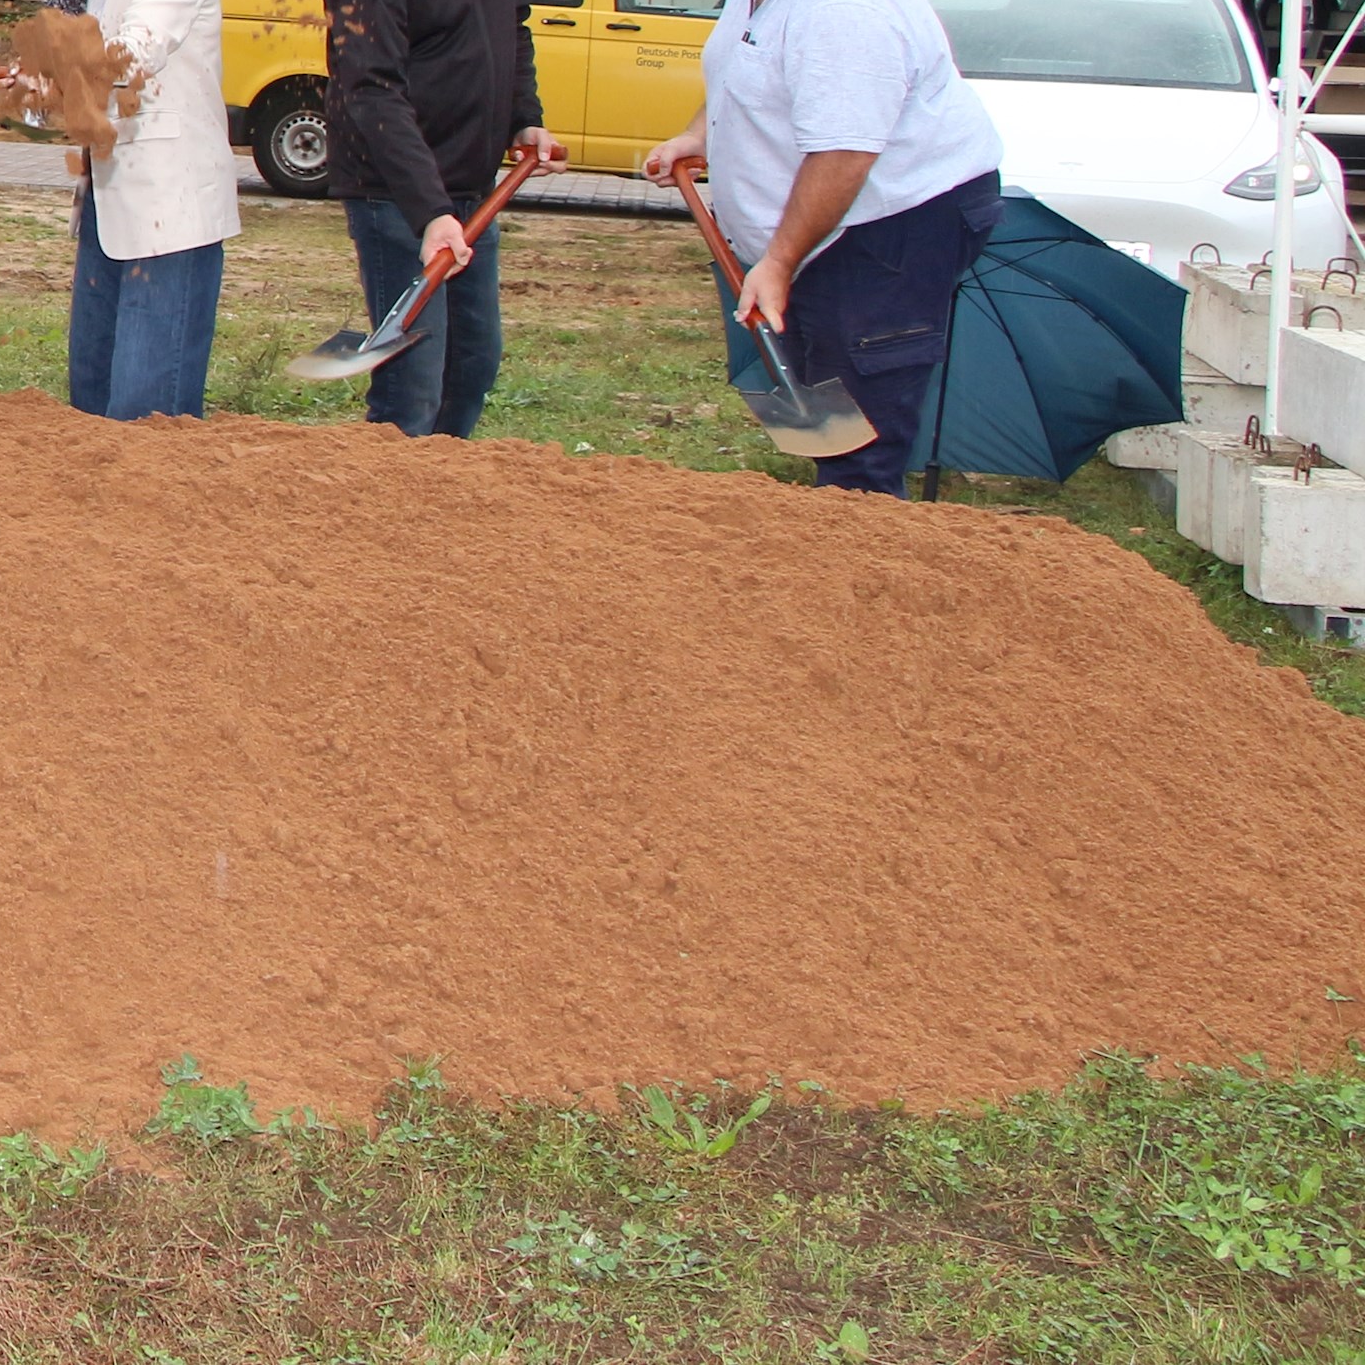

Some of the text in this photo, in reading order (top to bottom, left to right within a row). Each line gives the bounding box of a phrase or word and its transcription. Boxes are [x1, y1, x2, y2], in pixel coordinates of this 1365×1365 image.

[636, 46, 701, 60] Deutsche Post
[636, 57, 665, 70] Group
